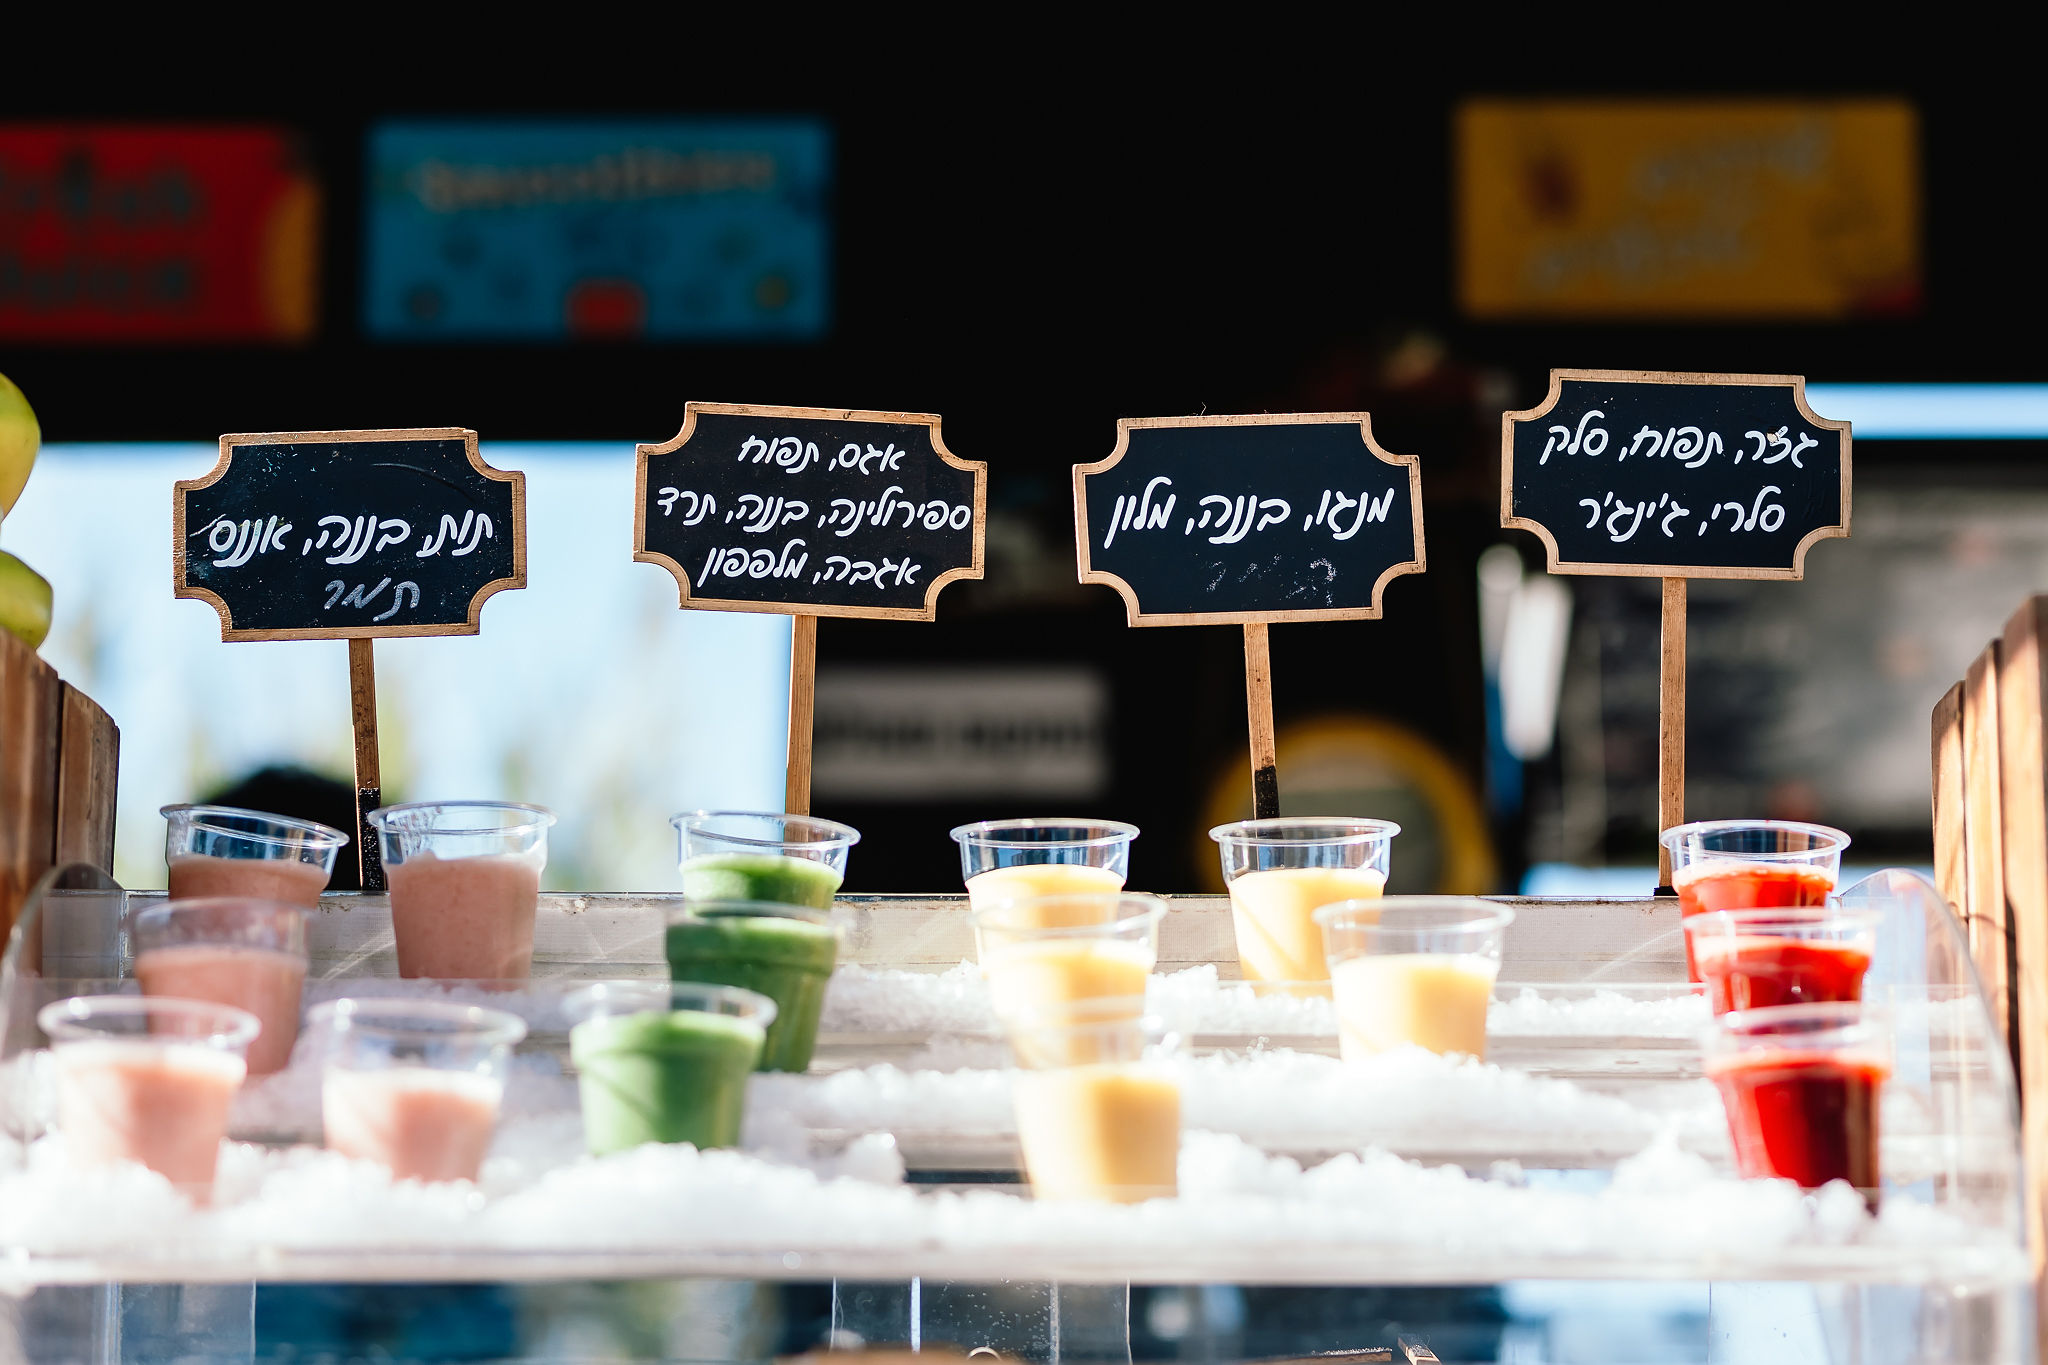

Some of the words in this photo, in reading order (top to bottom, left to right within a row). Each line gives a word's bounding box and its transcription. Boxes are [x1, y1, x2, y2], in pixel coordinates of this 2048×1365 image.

[738, 435, 820, 474] תפוח
[828, 443, 906, 475] אגס,
[1539, 410, 1609, 465] סלק
[1619, 425, 1724, 469] תפוח,
[657, 486, 717, 526] תרד
[725, 494, 810, 533] בננה,
[817, 486, 972, 537] ספירולינה,
[1103, 476, 1177, 549] מלון
[1184, 494, 1292, 545] בננה,
[1303, 487, 1395, 541] מנגו,
[1698, 485, 1786, 537] סלרי,
[208, 514, 293, 568] אננס
[302, 514, 411, 565] בננה,
[415, 509, 493, 558] תות,
[697, 538, 809, 588] מלפפון
[812, 556, 922, 590] אגבה,
[323, 576, 421, 622] תמר
